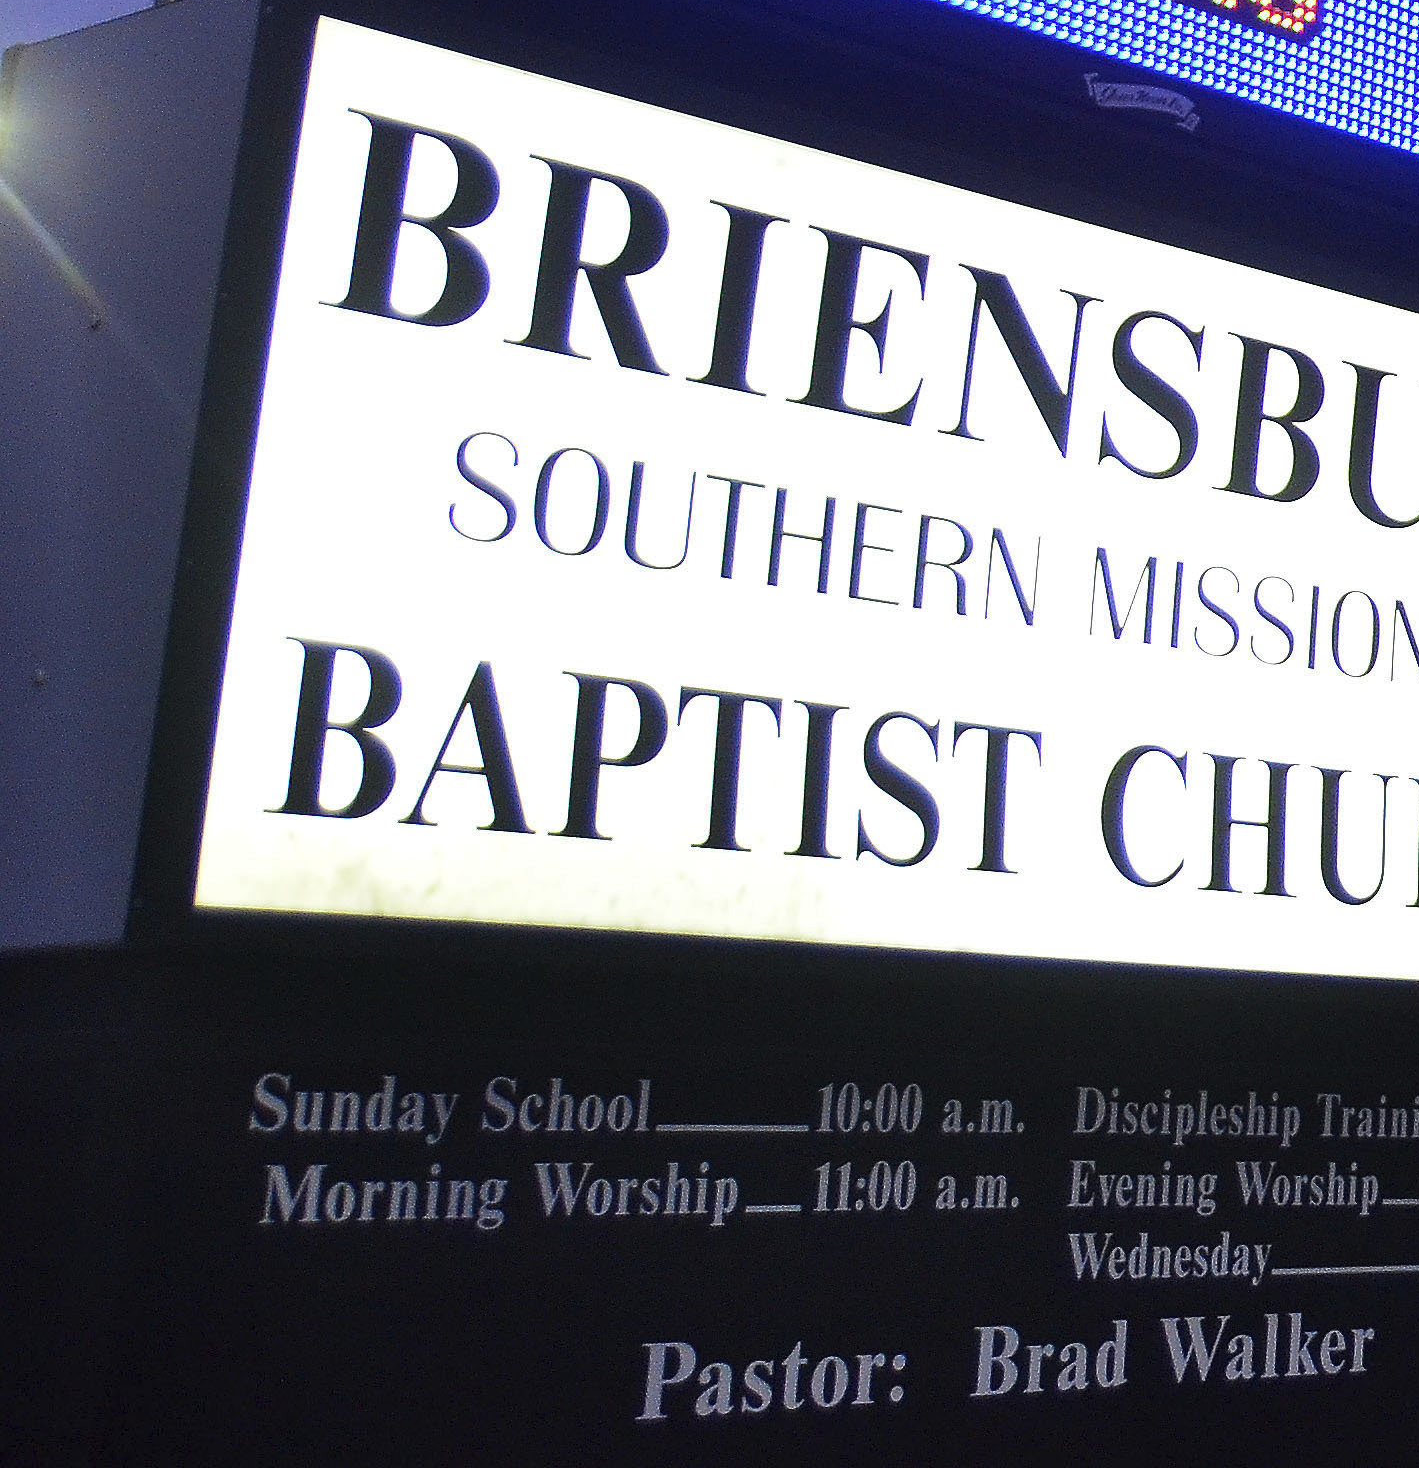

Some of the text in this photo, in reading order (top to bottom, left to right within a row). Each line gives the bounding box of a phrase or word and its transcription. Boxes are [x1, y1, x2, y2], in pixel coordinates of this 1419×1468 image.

[447, 430, 1041, 628] SOUTHERN
[263, 635, 1043, 875] BAPTIST
[247, 1072, 1026, 1145] Sunday School 10:00 a.m.
[1072, 1086, 1301, 1147] Discipleship
[258, 1159, 1020, 1231] Morning Worship 11:00 a.m.
[1067, 1159, 1219, 1216] Evening
[1234, 1161, 1380, 1216] Worship
[1067, 1231, 1273, 1287] Wednesday
[634, 1312, 1376, 1422] Pastor: Brad Walker
